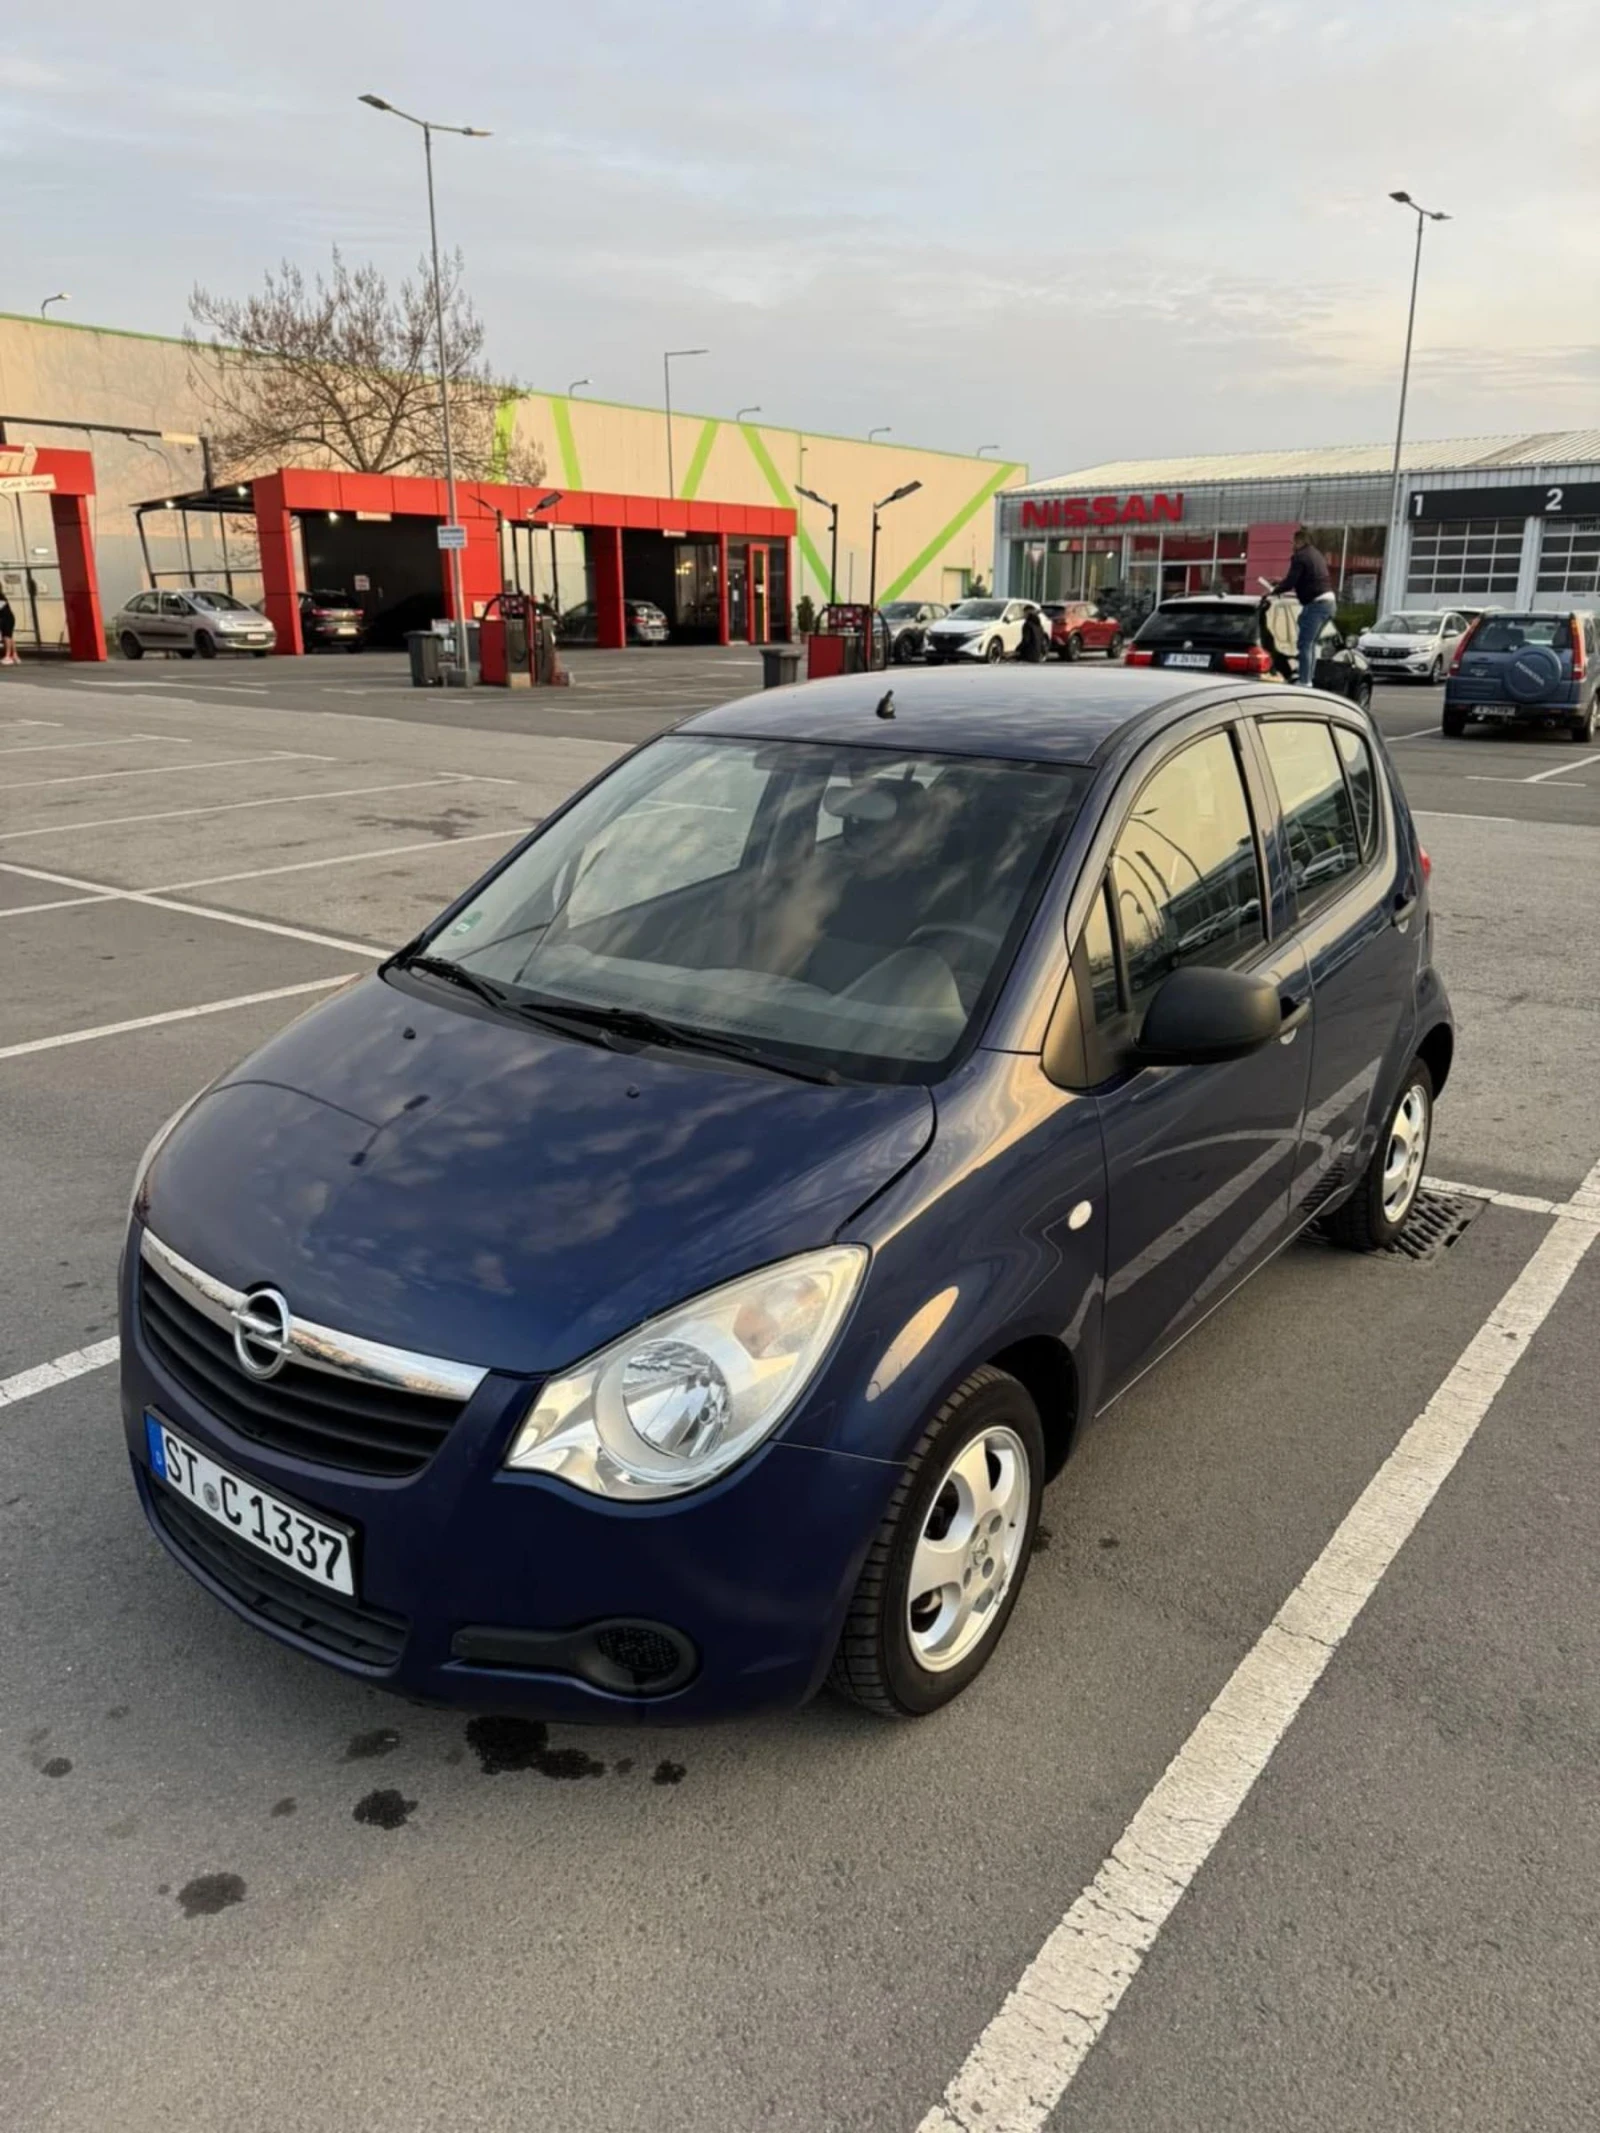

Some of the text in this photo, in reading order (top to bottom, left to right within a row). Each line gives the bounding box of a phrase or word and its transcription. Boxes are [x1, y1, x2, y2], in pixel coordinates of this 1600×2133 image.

[1021, 493, 1184, 528] NISSAN
[1414, 495, 1424, 517] 1
[1545, 488, 1562, 511] 2
[165, 1435, 198, 1496] ST
